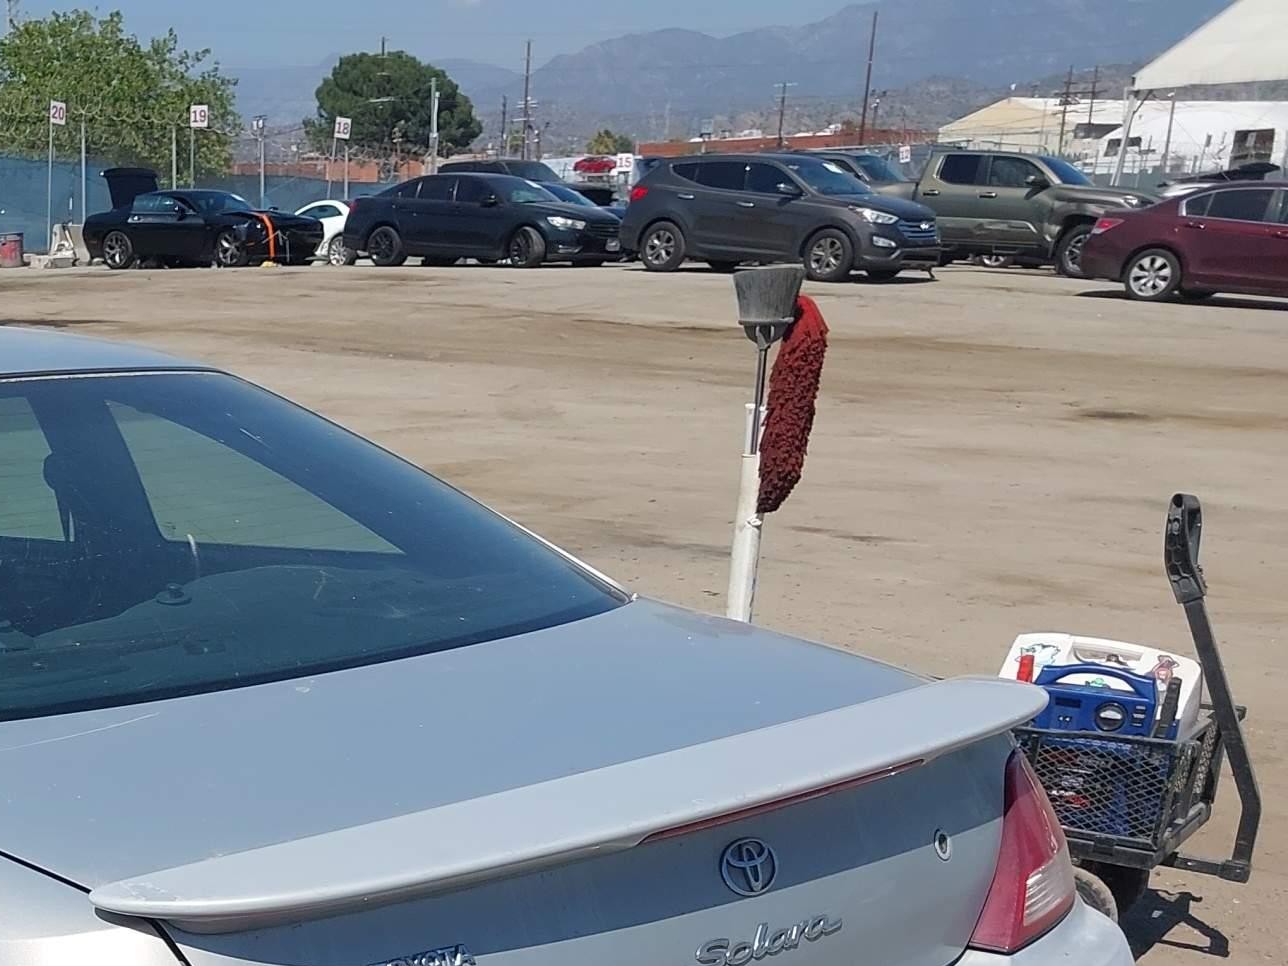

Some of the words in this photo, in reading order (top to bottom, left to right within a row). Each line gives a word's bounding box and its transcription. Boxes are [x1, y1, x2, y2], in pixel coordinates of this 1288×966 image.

[51, 105, 65, 120] 20
[191, 109, 207, 123] 19
[336, 122, 350, 135] 18
[618, 157, 632, 168] 15
